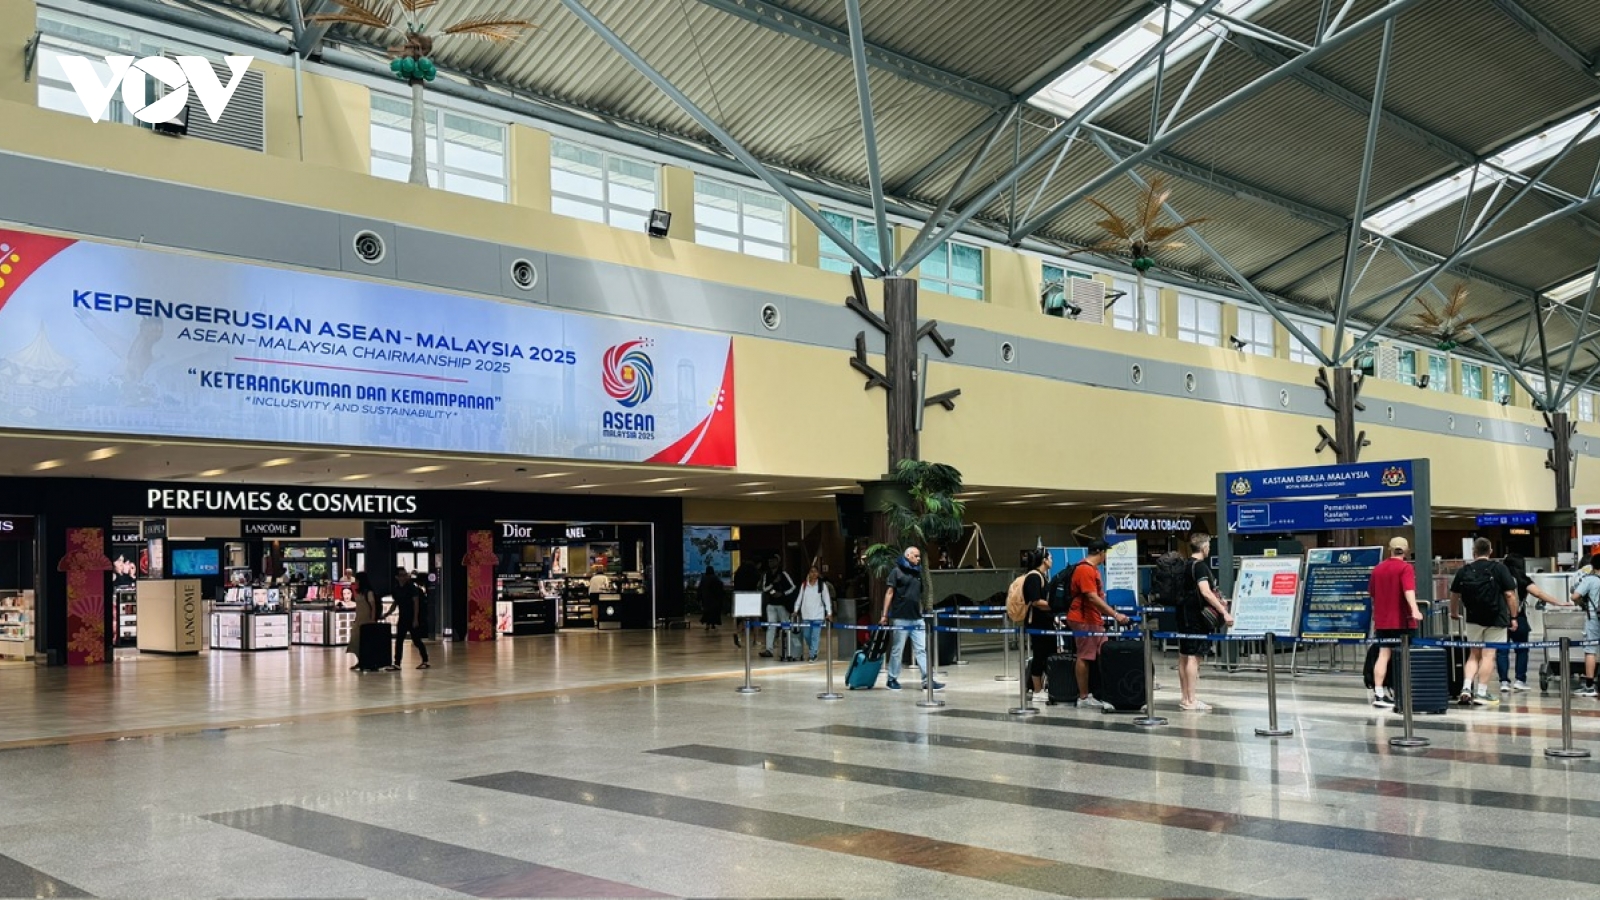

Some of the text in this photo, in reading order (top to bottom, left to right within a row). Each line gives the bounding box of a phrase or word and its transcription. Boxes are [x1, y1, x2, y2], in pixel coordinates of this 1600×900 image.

[72, 289, 312, 335] KEPENGERUSIAN
[529, 346, 577, 365] 2025
[352, 345, 472, 369] CHAIRMANSHIP
[475, 359, 511, 374] 2025
[356, 384, 387, 401] DAN
[333, 403, 360, 414] AND
[602, 410, 655, 432] ASEAN
[602, 430, 655, 441] MALAYSIA 2025
[1262, 470, 1370, 486] KASTAM DIRAJA MALAYSIA
[147, 488, 417, 514] PERFUMES & COSMETICS
[1323, 504, 1368, 513] Pemeriksaan
[390, 524, 410, 539] Dior
[502, 523, 533, 538] Dior
[1119, 517, 1192, 531] LIQUOR & TOBACCO
